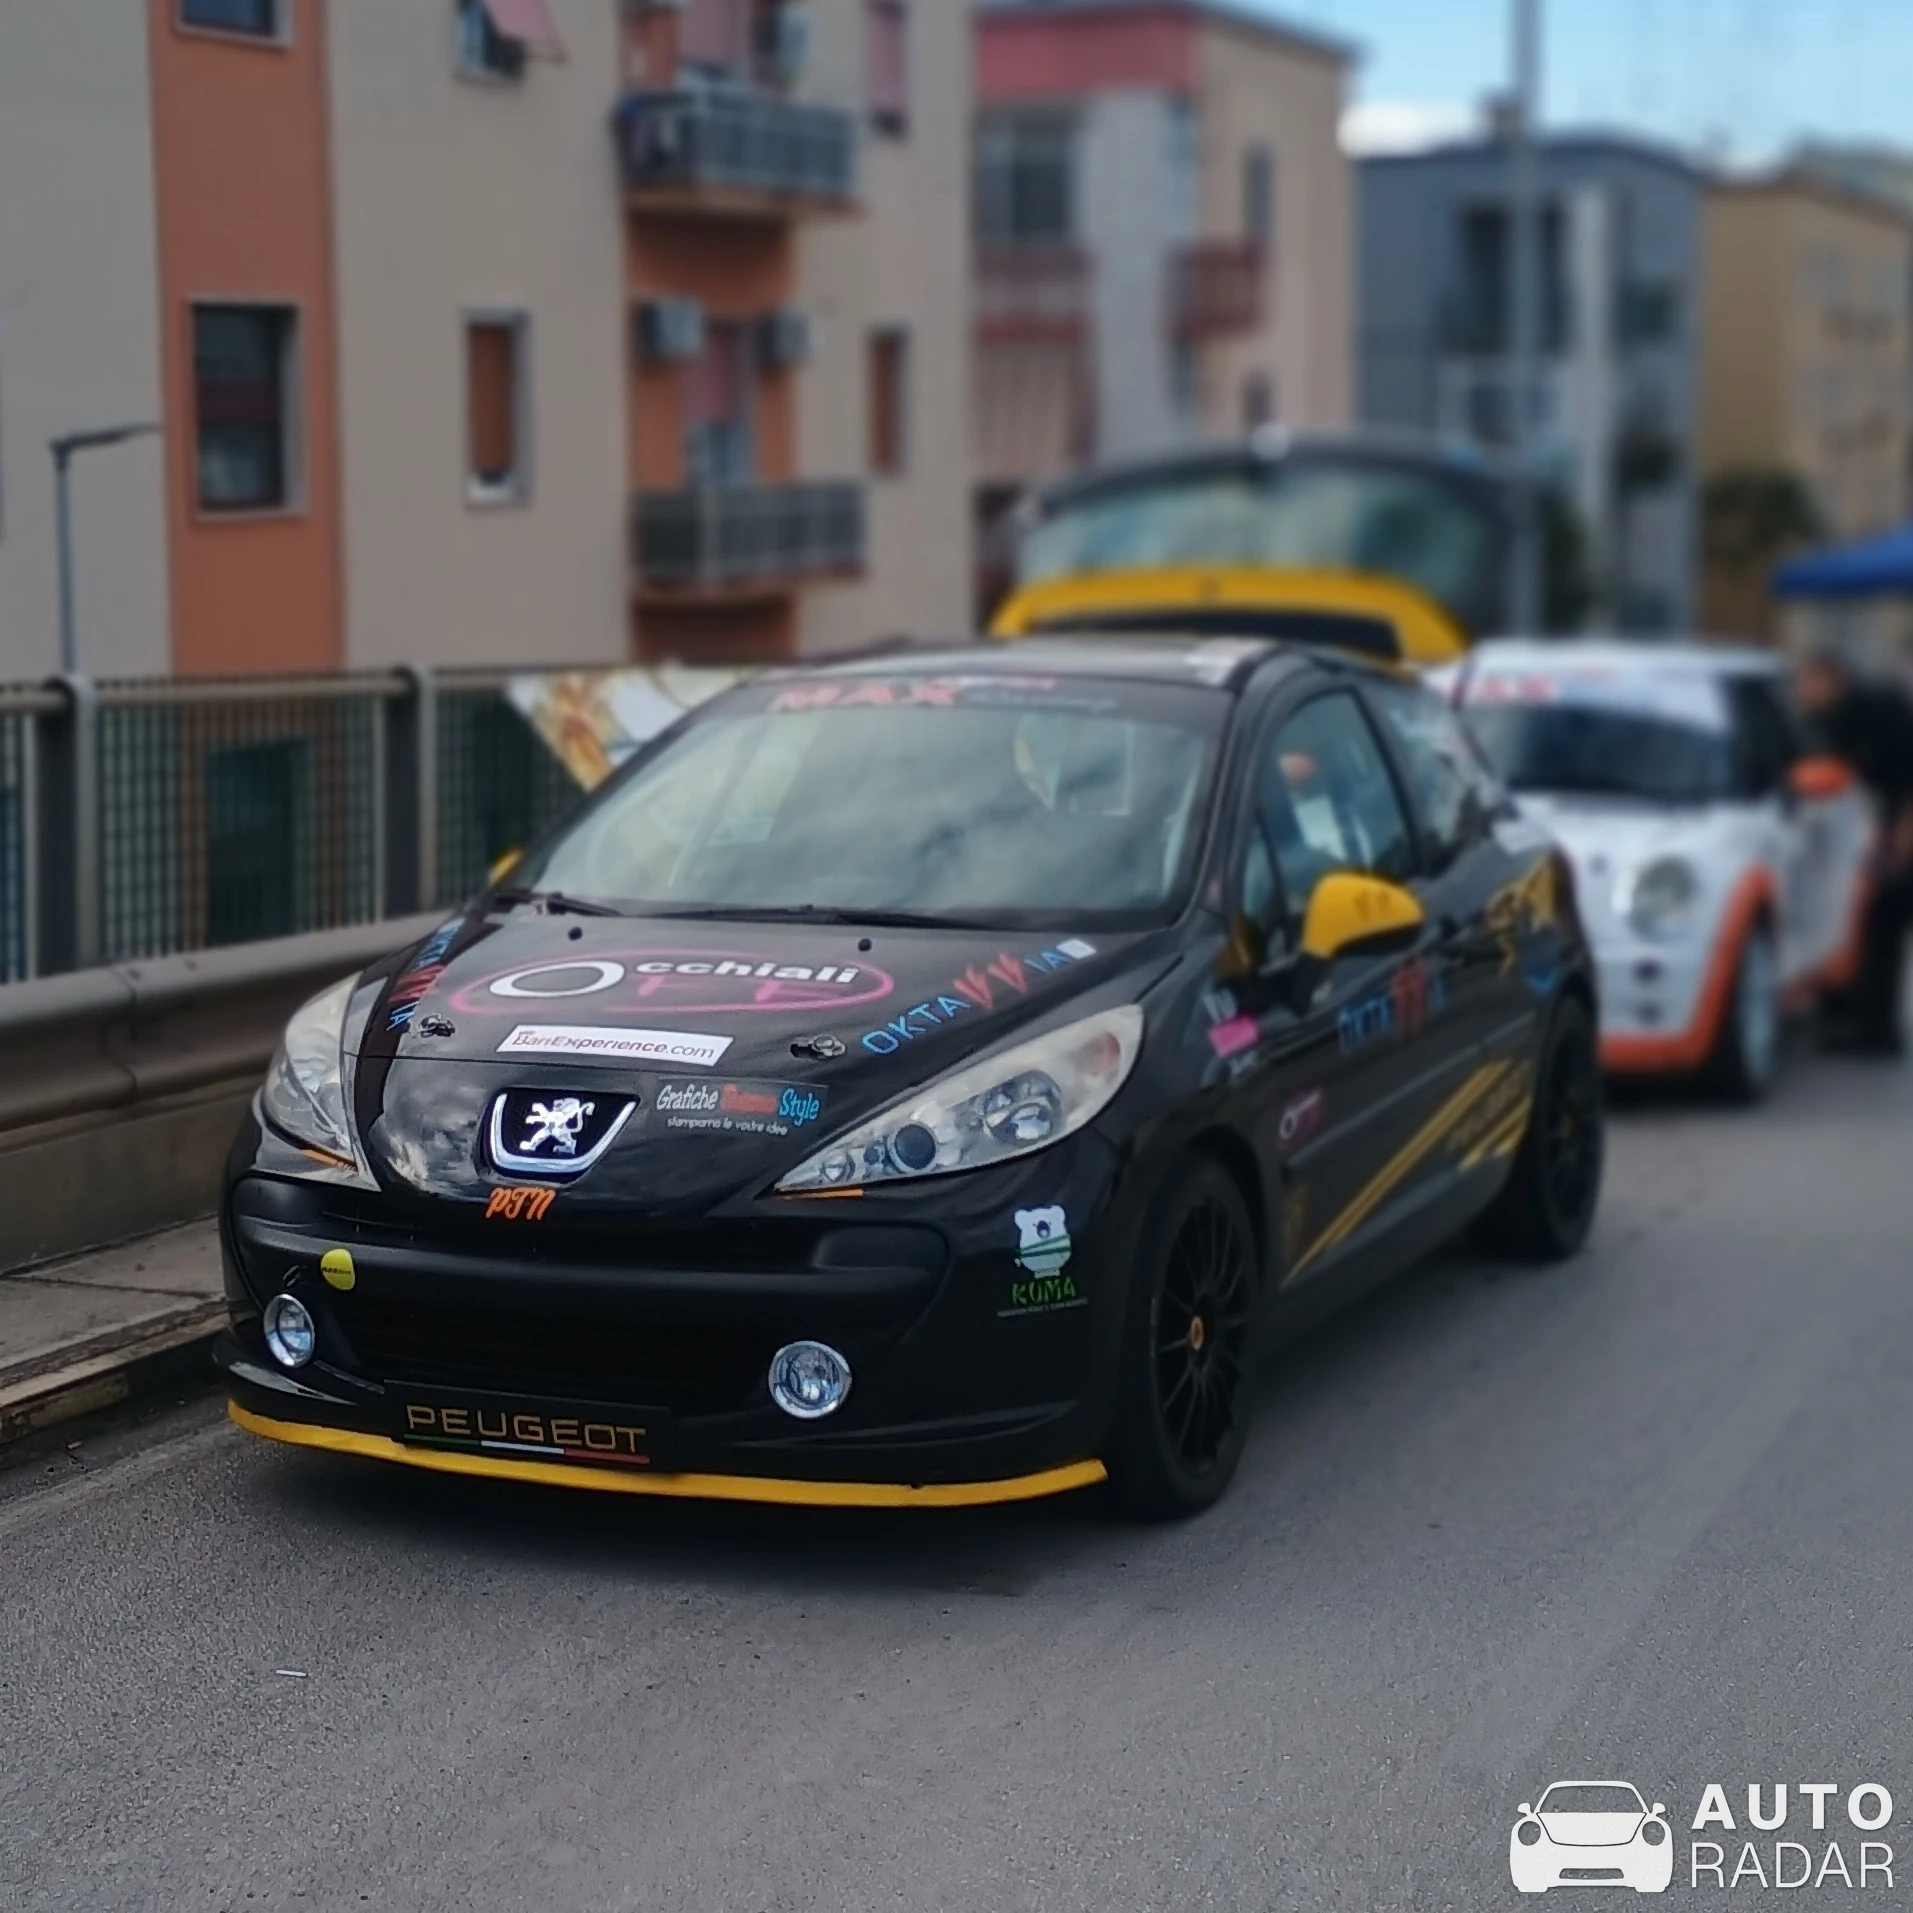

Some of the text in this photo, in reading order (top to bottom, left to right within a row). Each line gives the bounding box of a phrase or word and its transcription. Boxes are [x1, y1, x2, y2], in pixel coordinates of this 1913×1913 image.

[488, 961, 860, 998] Occhiali
[656, 1083, 719, 1111] Grafiche
[779, 1088, 820, 1127] Style
[1012, 1276, 1077, 1305] KUMA
[406, 1404, 647, 1453] PEUGEOT
